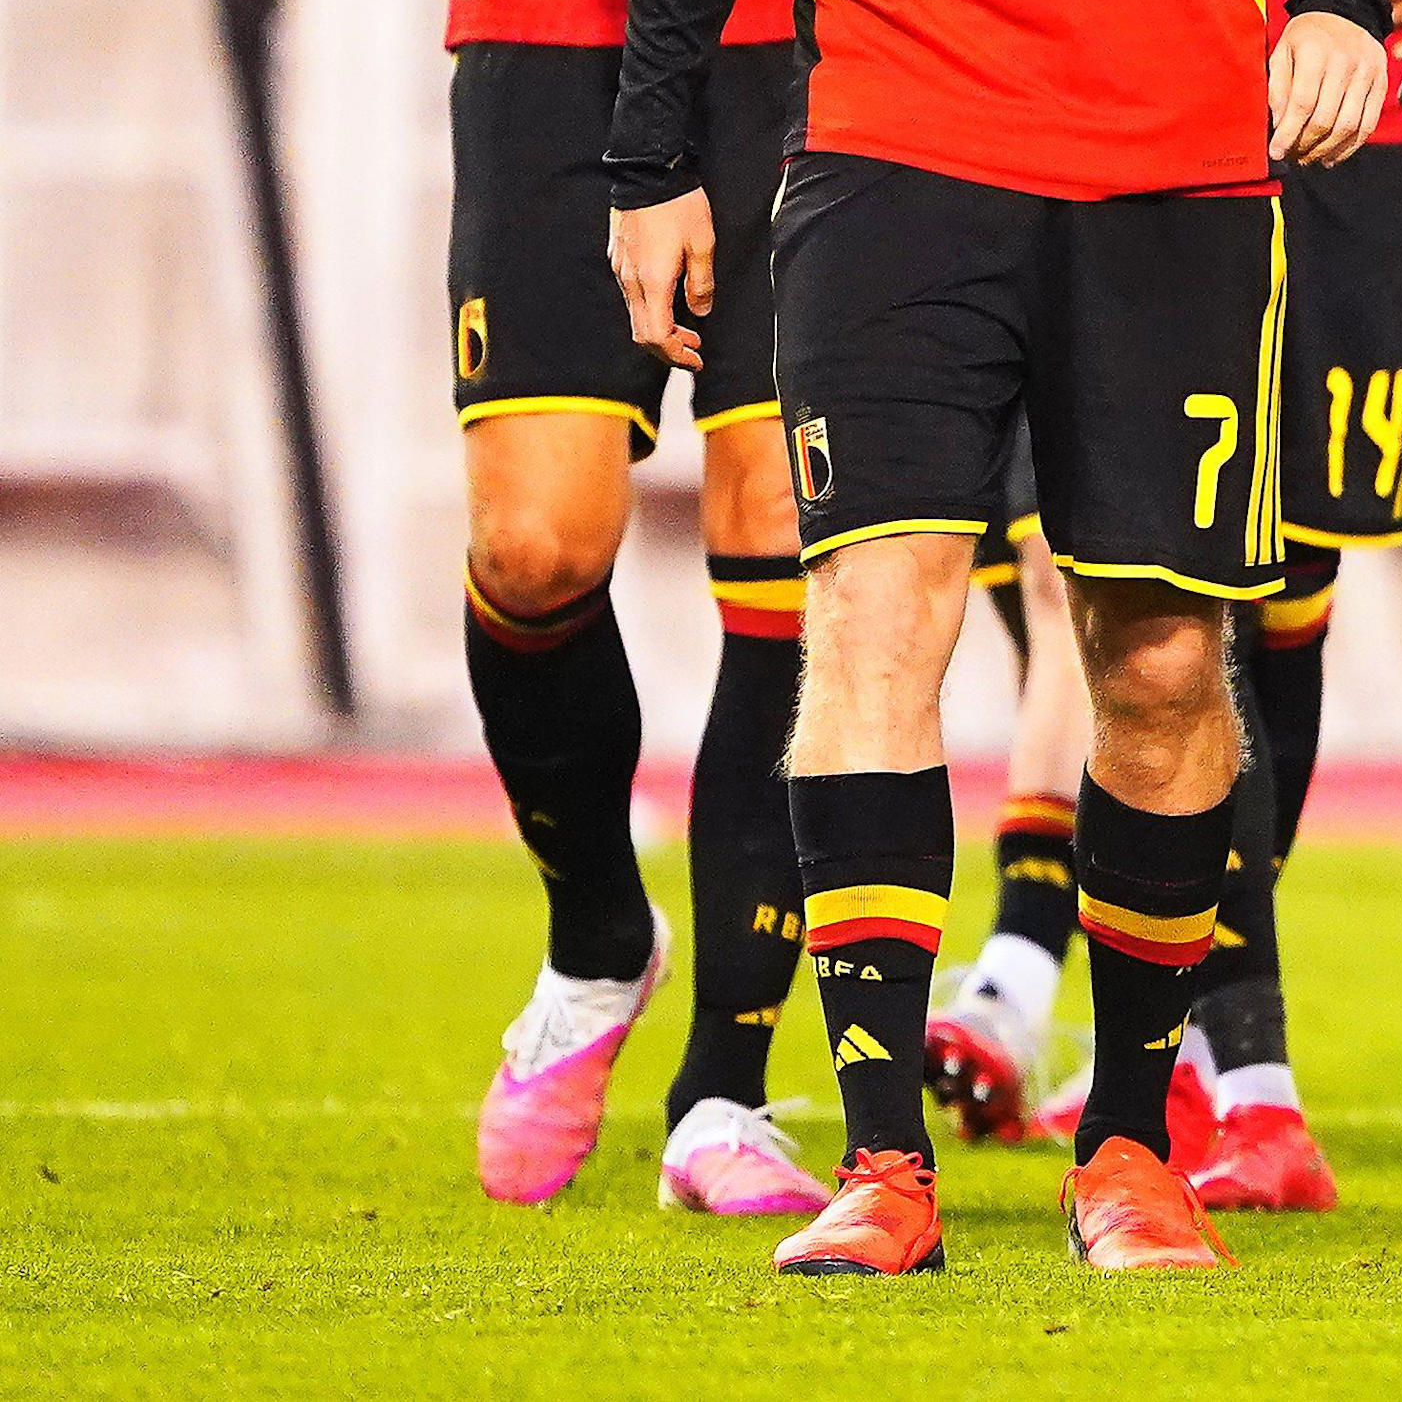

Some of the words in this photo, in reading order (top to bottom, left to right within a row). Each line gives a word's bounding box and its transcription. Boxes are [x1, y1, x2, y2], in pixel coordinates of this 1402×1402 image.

[1184, 393, 1238, 528] 7
[752, 903, 807, 945] RB
[814, 955, 883, 982] BFA
